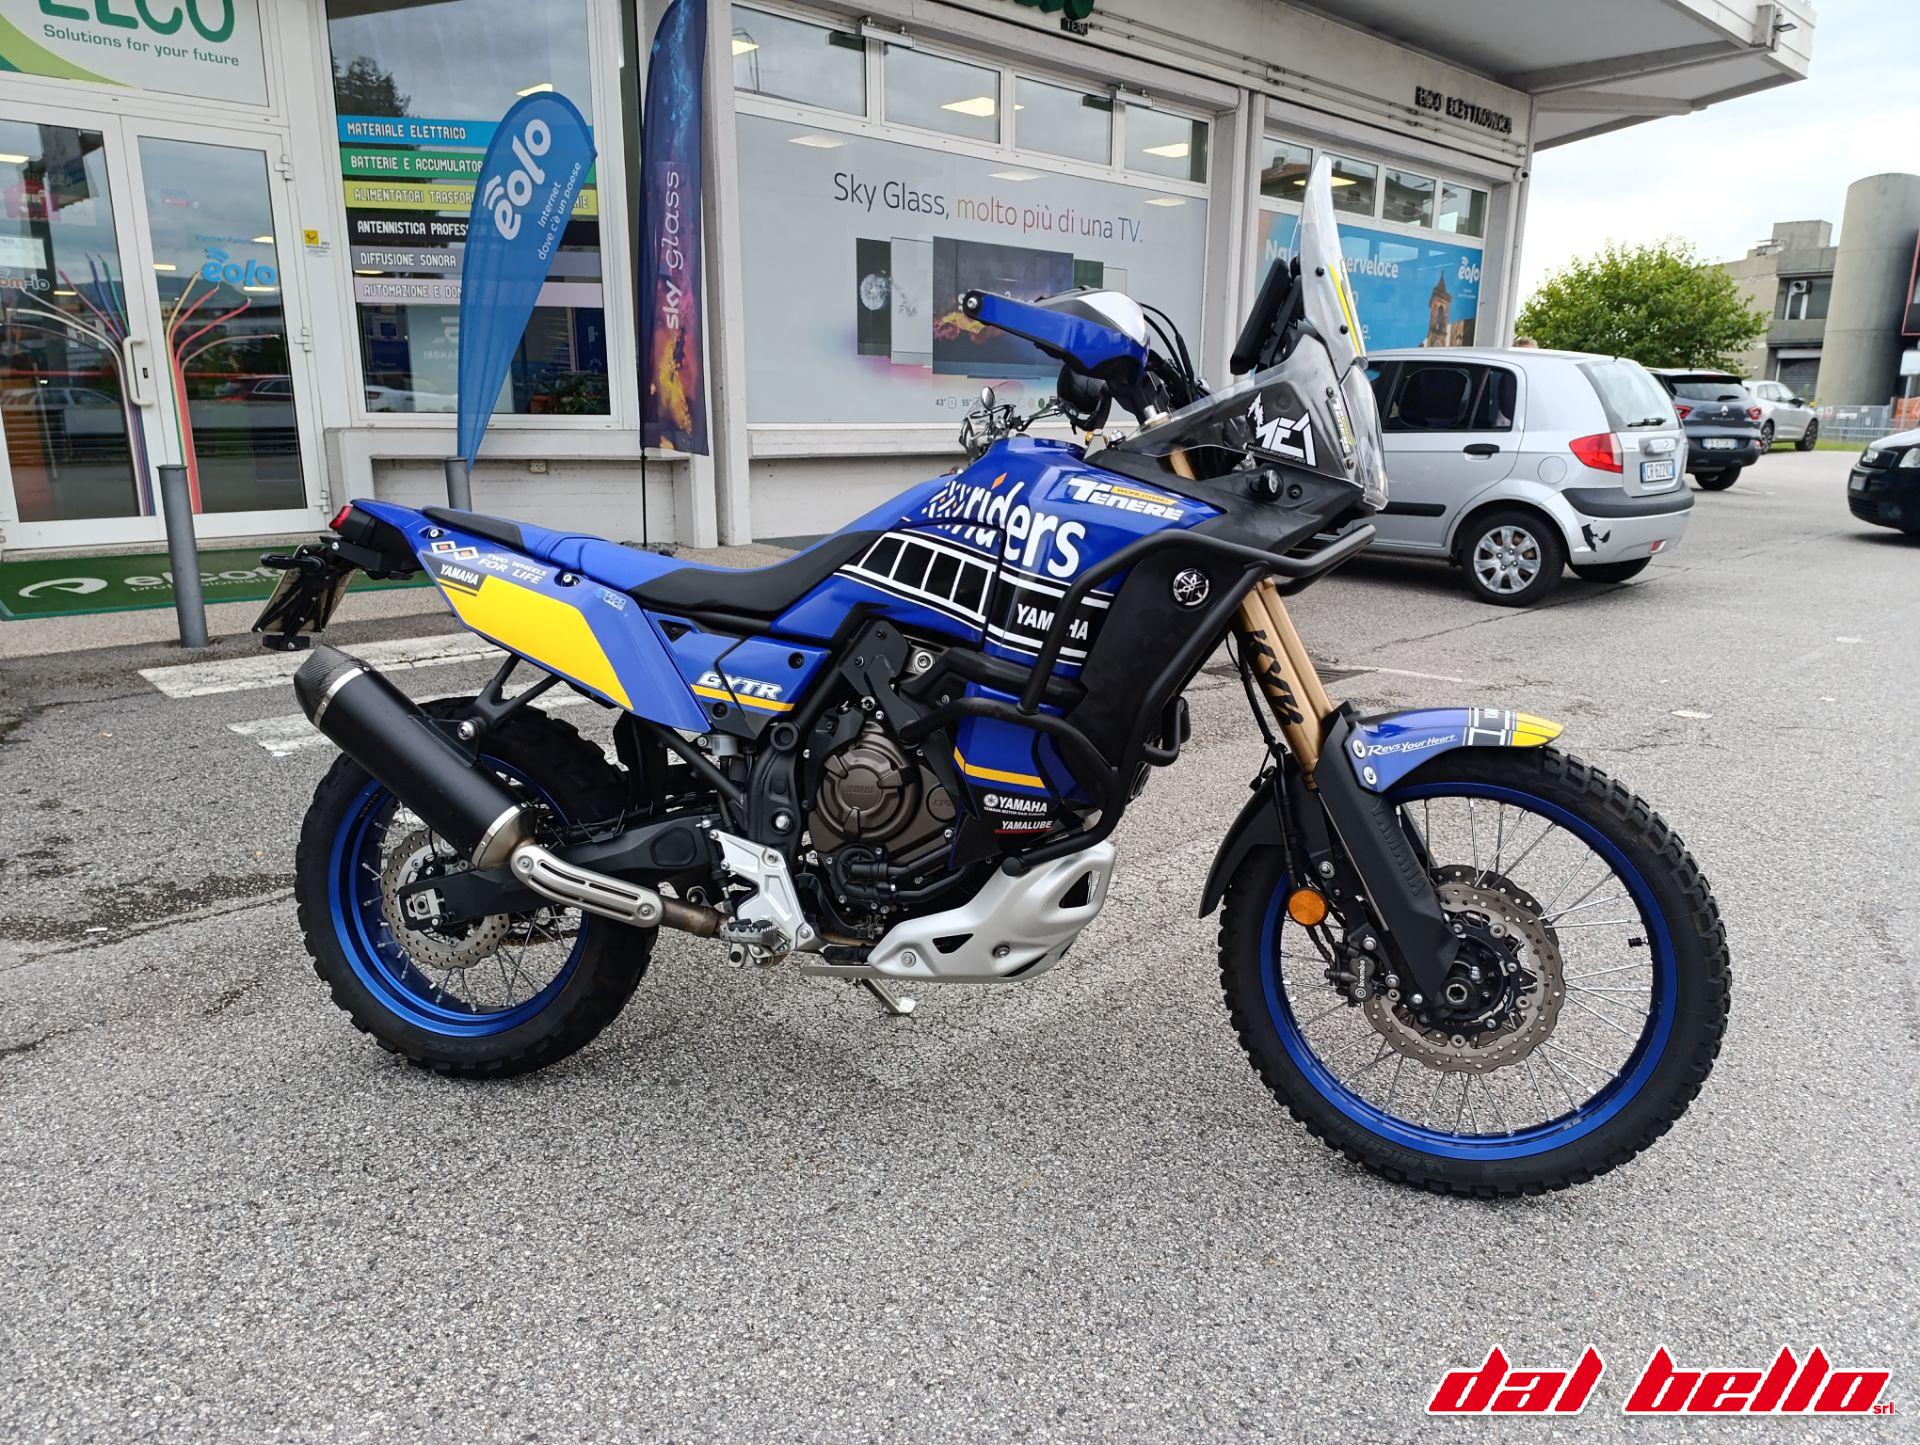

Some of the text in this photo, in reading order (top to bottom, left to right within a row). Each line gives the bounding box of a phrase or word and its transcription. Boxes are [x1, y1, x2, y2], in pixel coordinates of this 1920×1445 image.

[43, 24, 240, 67] Solutions for your future
[346, 122, 466, 140] MATERIALE ELETTRICO
[350, 155, 398, 170] BATTERIE
[403, 157, 410, 170] E
[354, 188, 424, 203] ALIMENTATORI
[537, 181, 562, 228] Internet
[538, 232, 555, 262] dove
[557, 197, 571, 217] un
[564, 161, 582, 201] paese
[833, 172, 1144, 244] Sky Glass, molto più di una TV.
[357, 220, 426, 235] ANTENNISTICA
[360, 252, 457, 267] DIFFUSIONE SONORA
[661, 170, 684, 330] sky glass
[202, 255, 277, 287] eolo
[1458, 261, 1480, 284] eolo
[363, 283, 429, 298] AUTOMAZIONE
[433, 285, 440, 298] E
[440, 563, 480, 586] YAMAHA
[478, 558, 543, 585] FOR LIFE
[487, 554, 548, 577] TWO WHEELS
[1016, 602, 1089, 641] YAMHA
[696, 670, 784, 701] GYTR
[1367, 743, 1402, 757] Revs
[1401, 740, 1427, 753] Your
[999, 796, 1048, 813] YAMAHA
[1001, 820, 1053, 830] YAMALUBE
[1357, 960, 1366, 987] brembo
